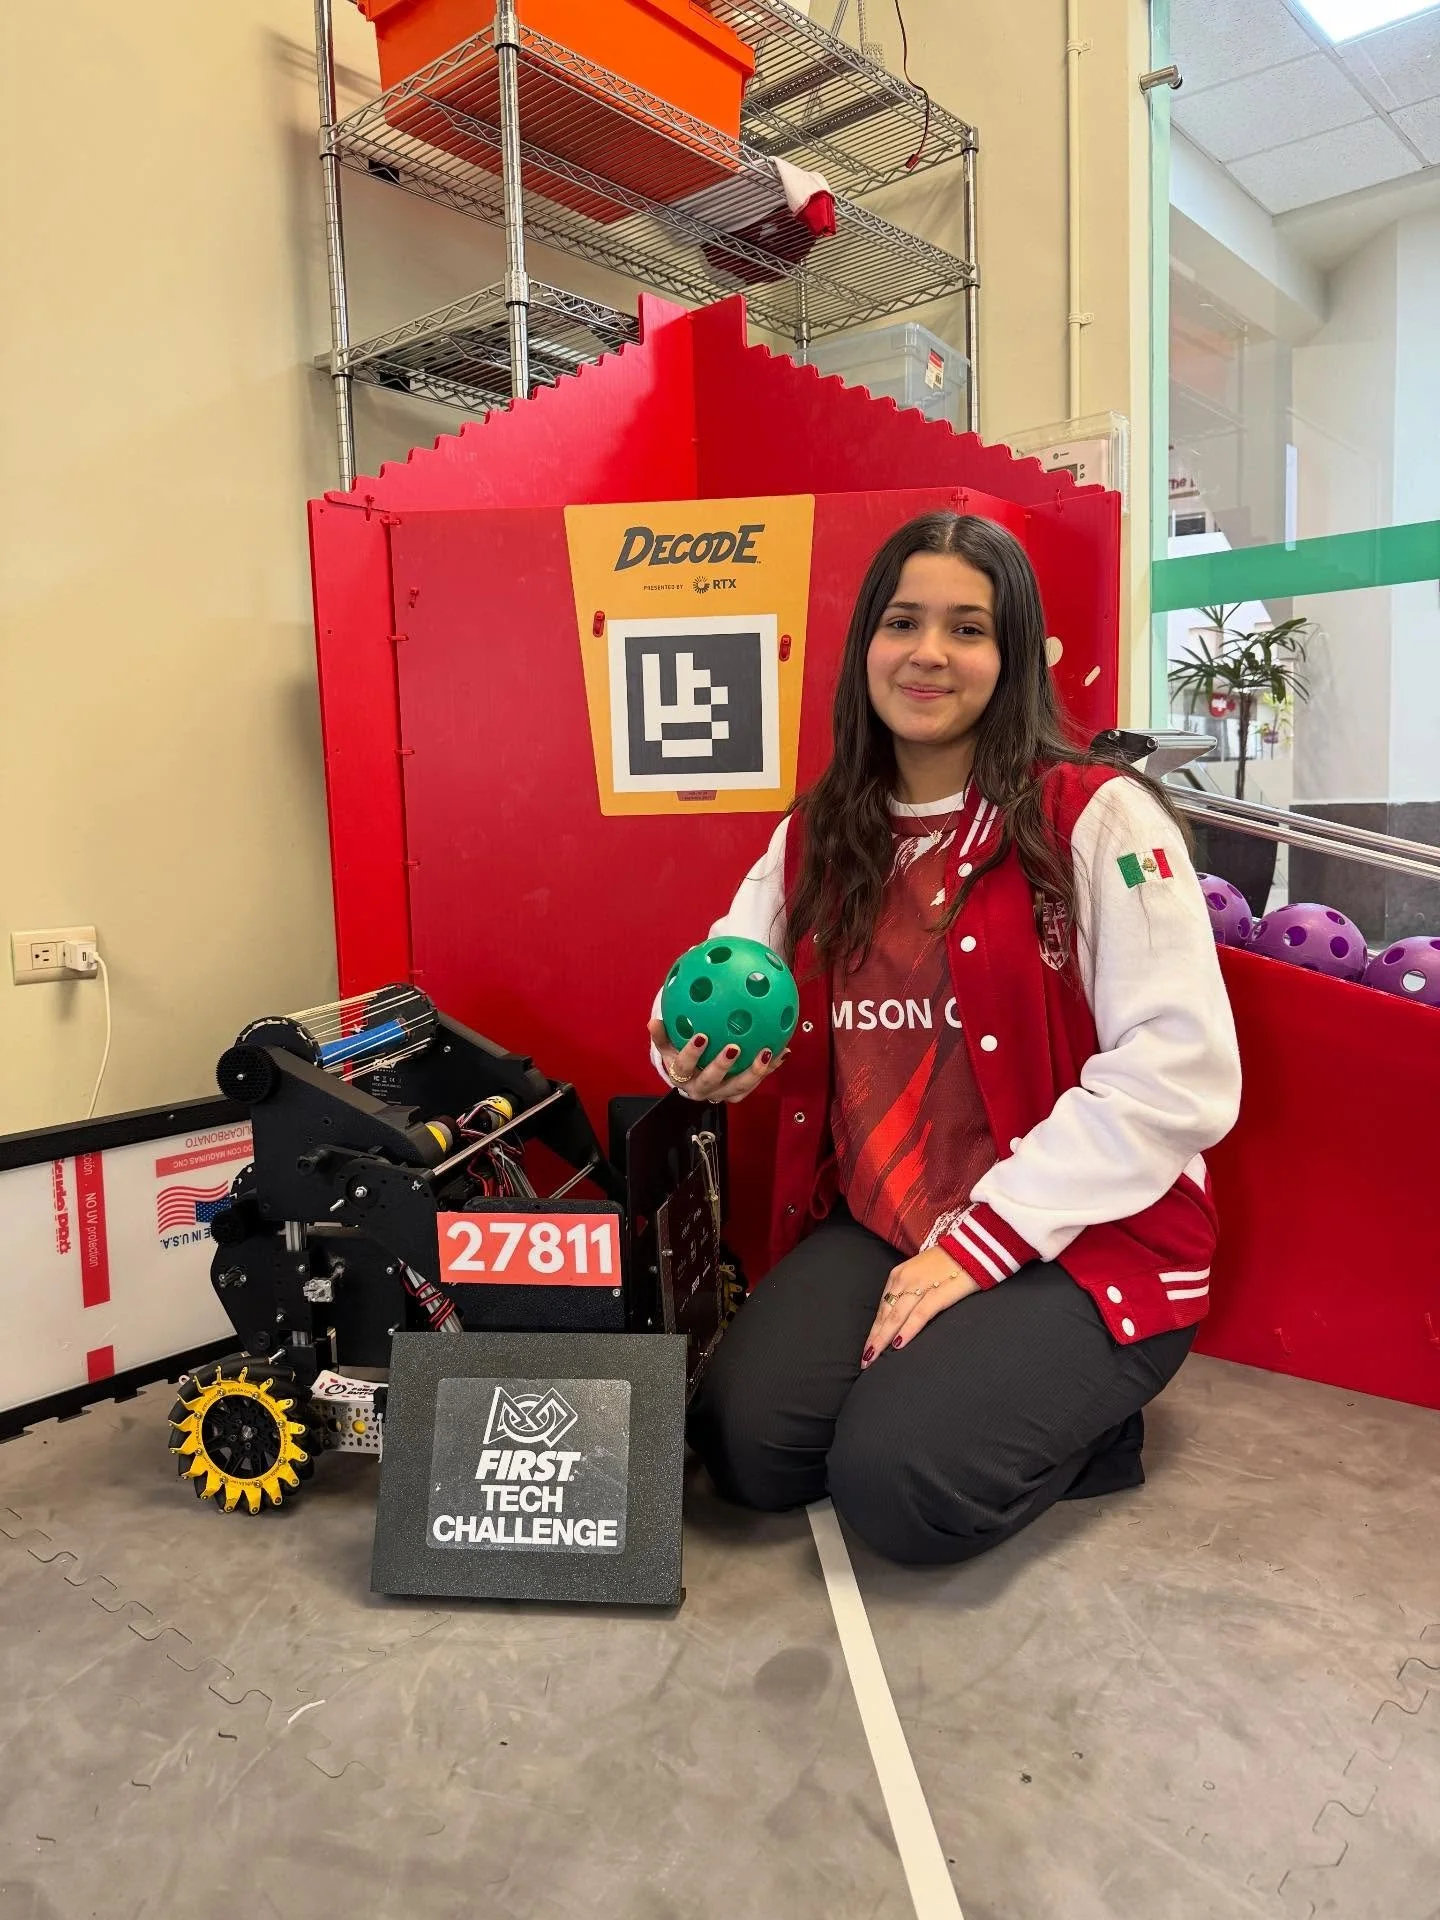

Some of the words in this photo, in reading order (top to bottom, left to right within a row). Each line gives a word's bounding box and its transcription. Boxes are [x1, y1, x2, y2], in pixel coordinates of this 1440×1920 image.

[614, 524, 765, 571] DECODE
[713, 579, 737, 590] RTX
[173, 1158, 189, 1169] CNC
[86, 1193, 97, 1208] NO
[86, 1210, 98, 1224] UV
[160, 1233, 189, 1249] U.S.A.
[192, 1230, 201, 1242] IN
[86, 1226, 99, 1268] protection
[446, 1220, 613, 1274] 27811
[480, 1485, 563, 1512] TECH
[432, 1515, 618, 1547] CHALLENGE
